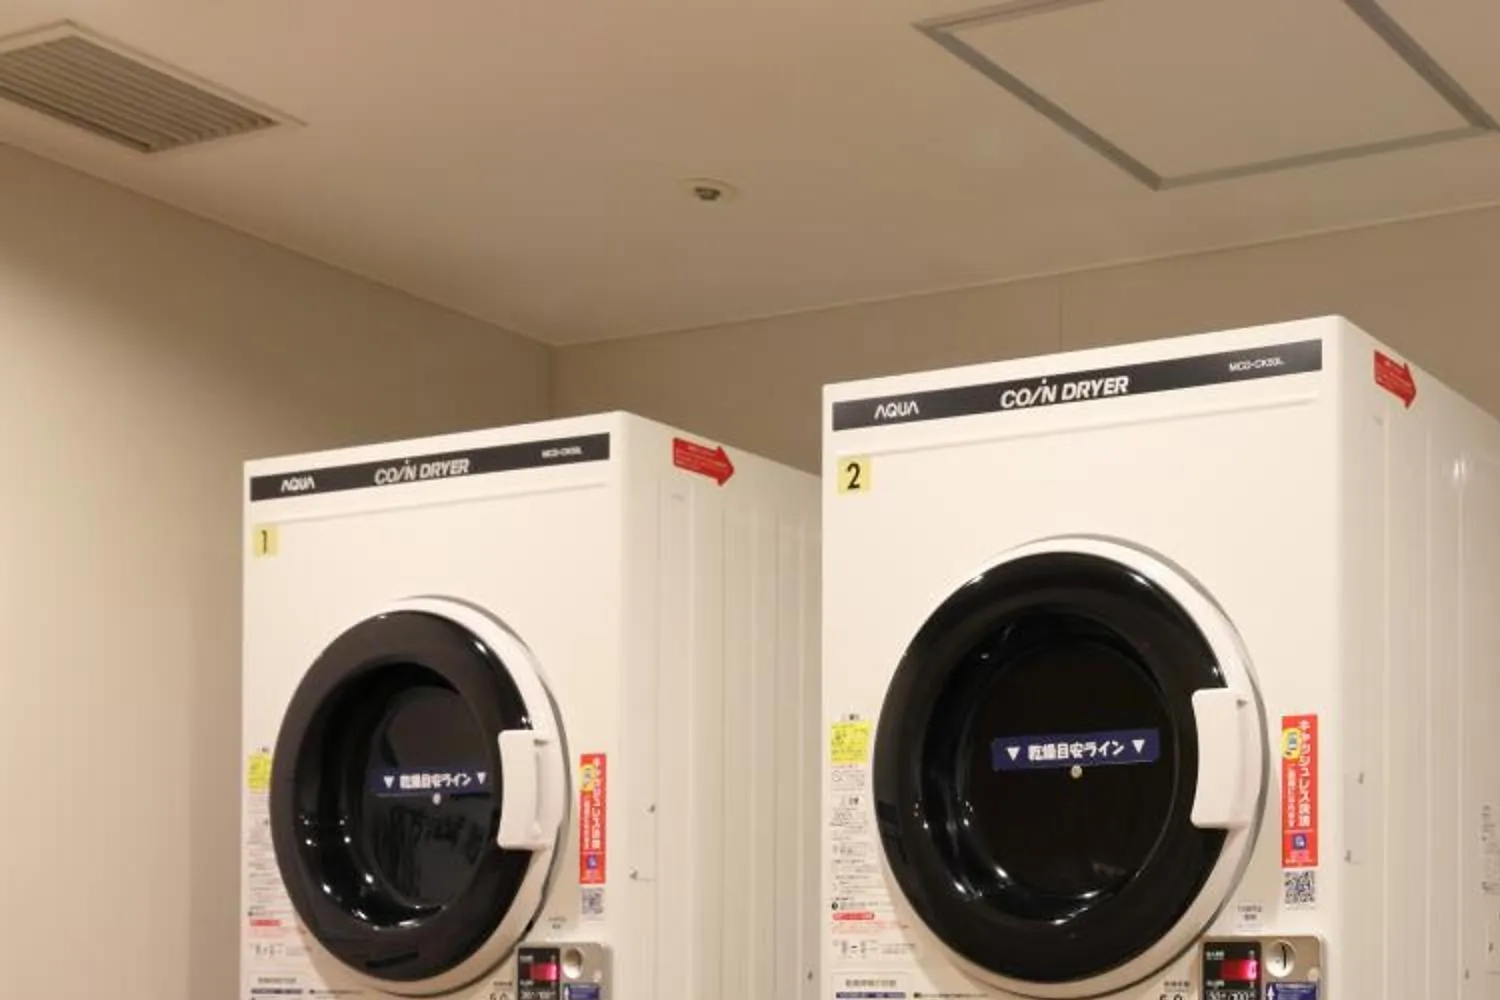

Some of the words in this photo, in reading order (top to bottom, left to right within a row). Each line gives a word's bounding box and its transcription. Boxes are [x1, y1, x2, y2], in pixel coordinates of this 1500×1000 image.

[874, 400, 919, 420] AQUA
[1061, 374, 1130, 401] DRYER
[281, 475, 316, 493] AQUA
[419, 457, 471, 479] DRYER
[846, 462, 861, 491] 2
[260, 530, 269, 554] 1
[1027, 740, 1125, 761] 乾燥目安ライン
